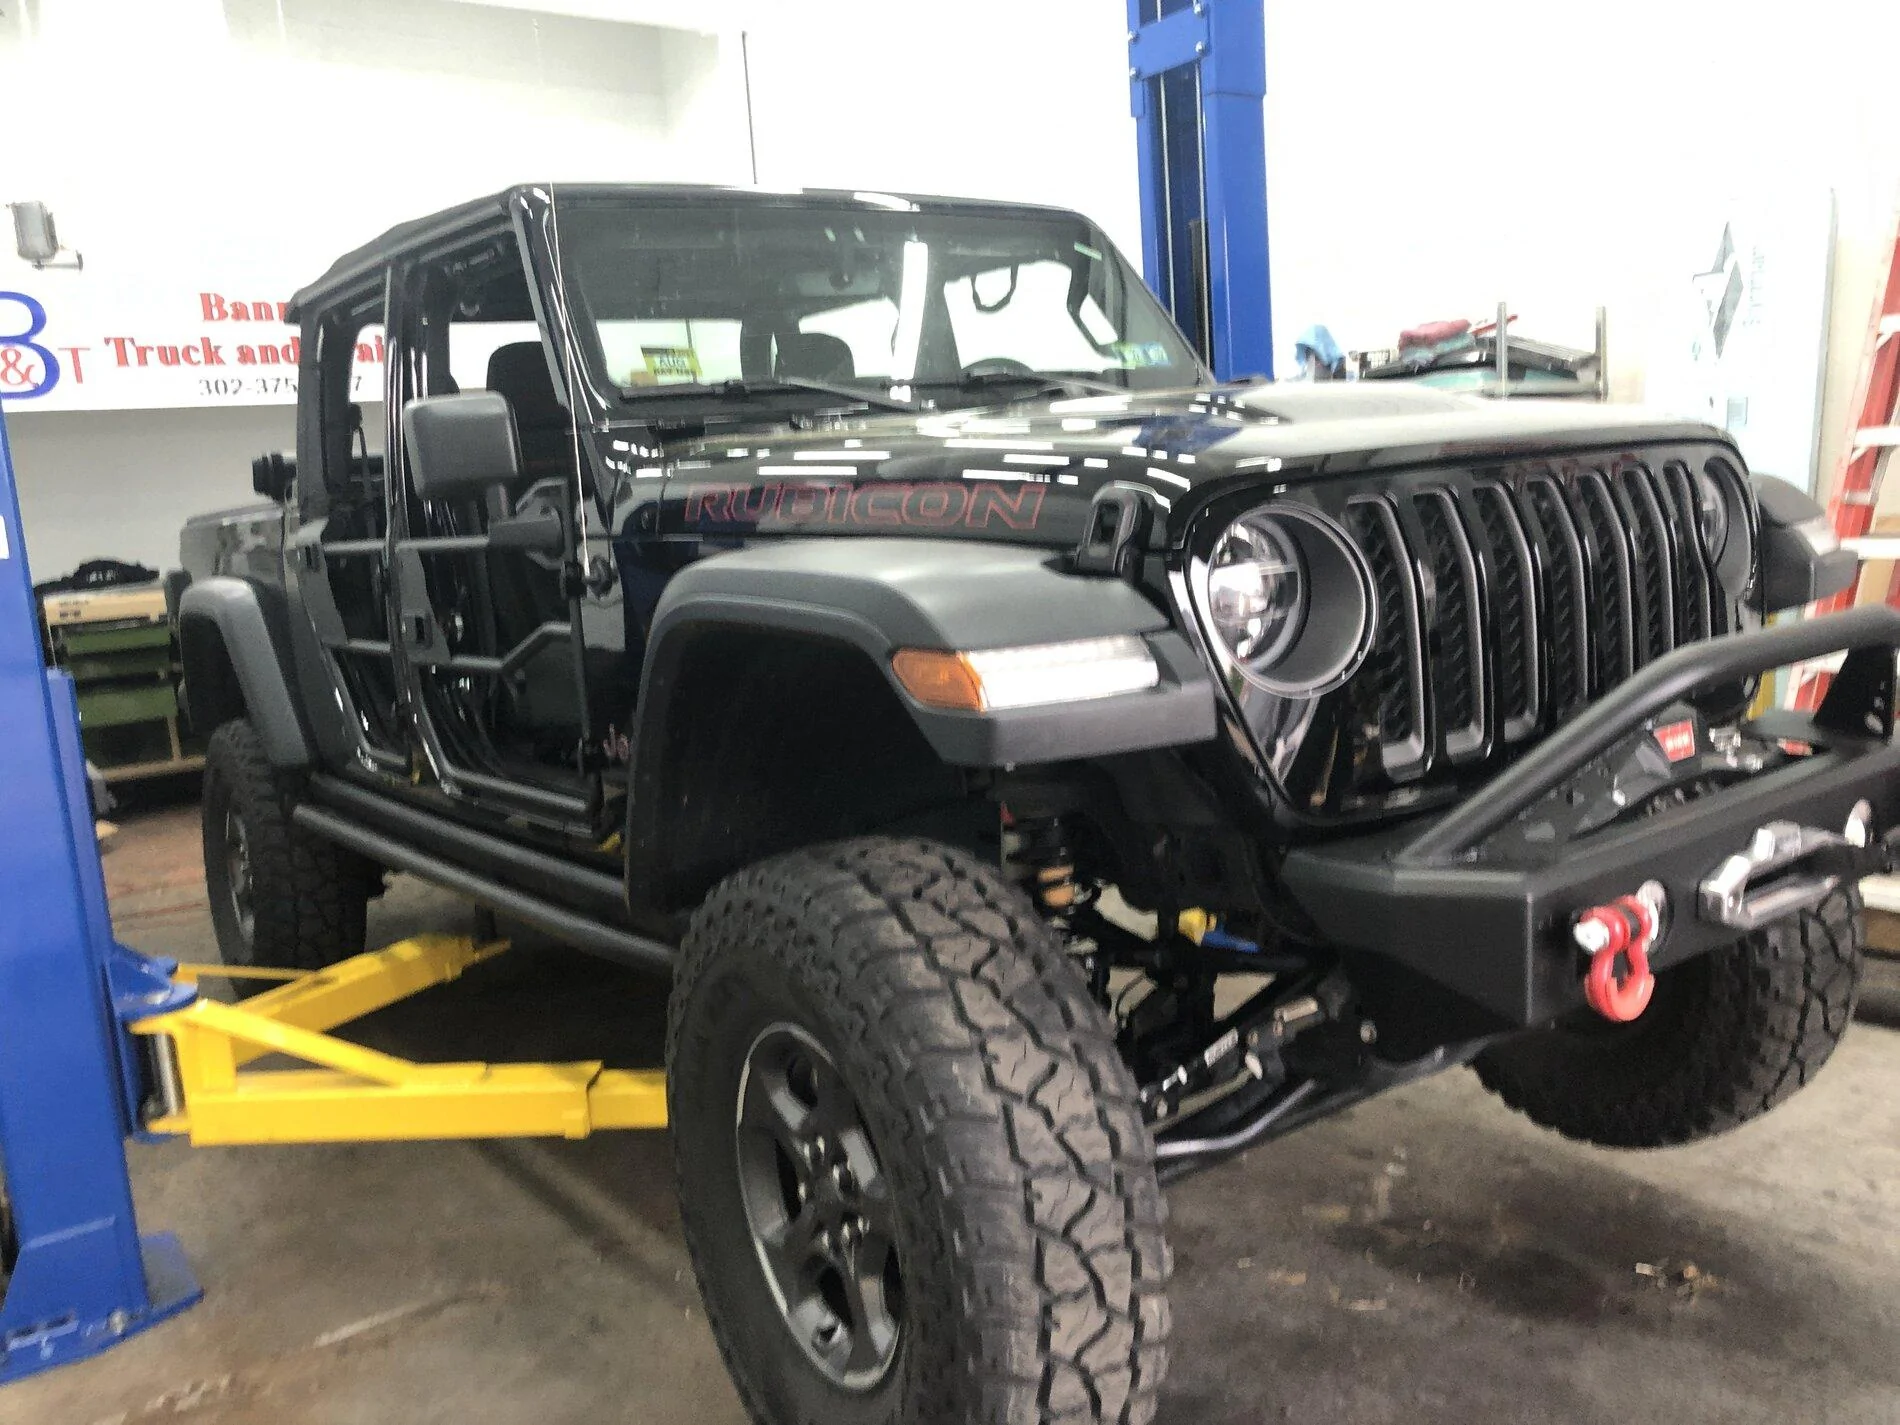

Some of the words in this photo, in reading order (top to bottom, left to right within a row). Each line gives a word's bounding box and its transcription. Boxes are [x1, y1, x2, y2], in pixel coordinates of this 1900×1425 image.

[104, 336, 226, 367] Truck
[236, 336, 301, 365] and
[684, 481, 1046, 530] RUBICON
